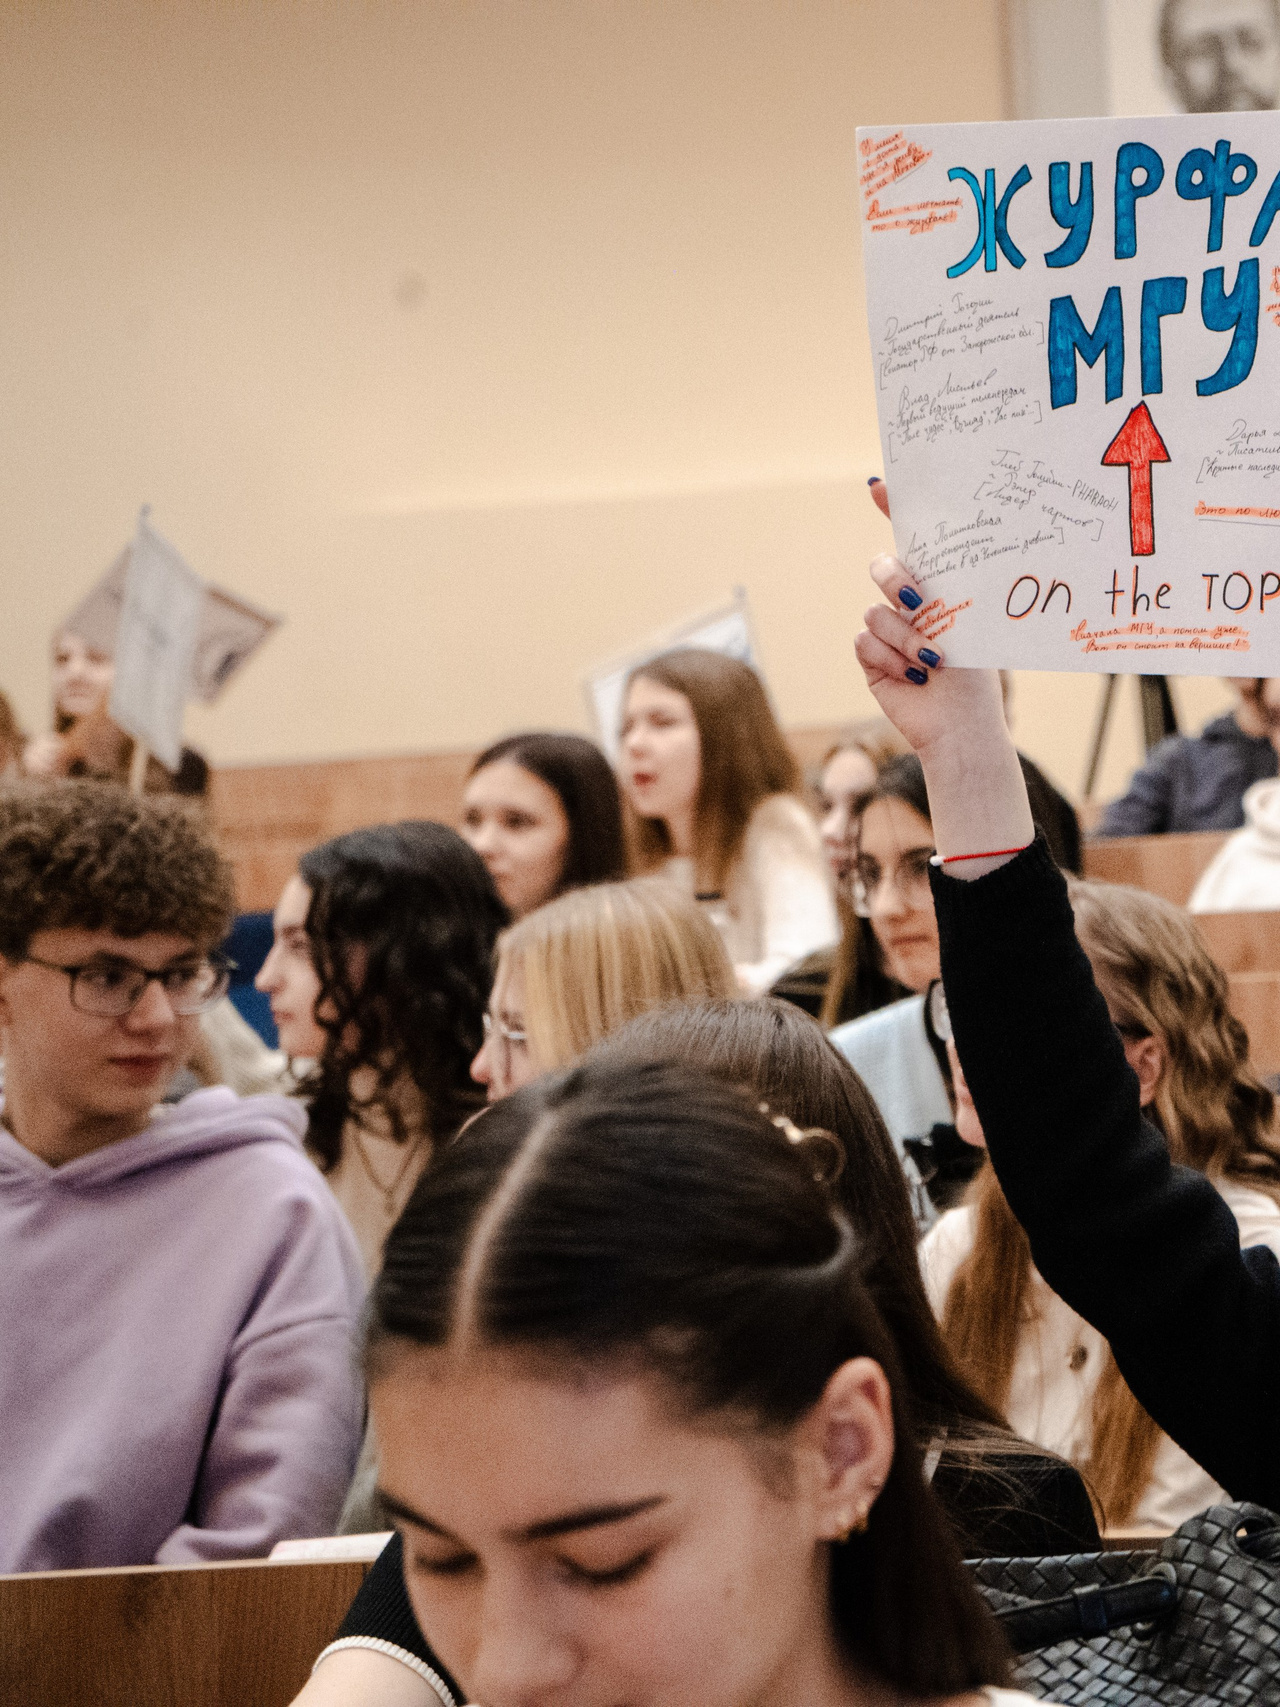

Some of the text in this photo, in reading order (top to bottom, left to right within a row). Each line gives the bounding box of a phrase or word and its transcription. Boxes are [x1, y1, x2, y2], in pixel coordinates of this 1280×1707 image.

[1047, 257, 1260, 410] МГУ
[1225, 418, 1266, 444] Дарья
[1006, 575, 1071, 619] On
[1104, 565, 1172, 617] the
